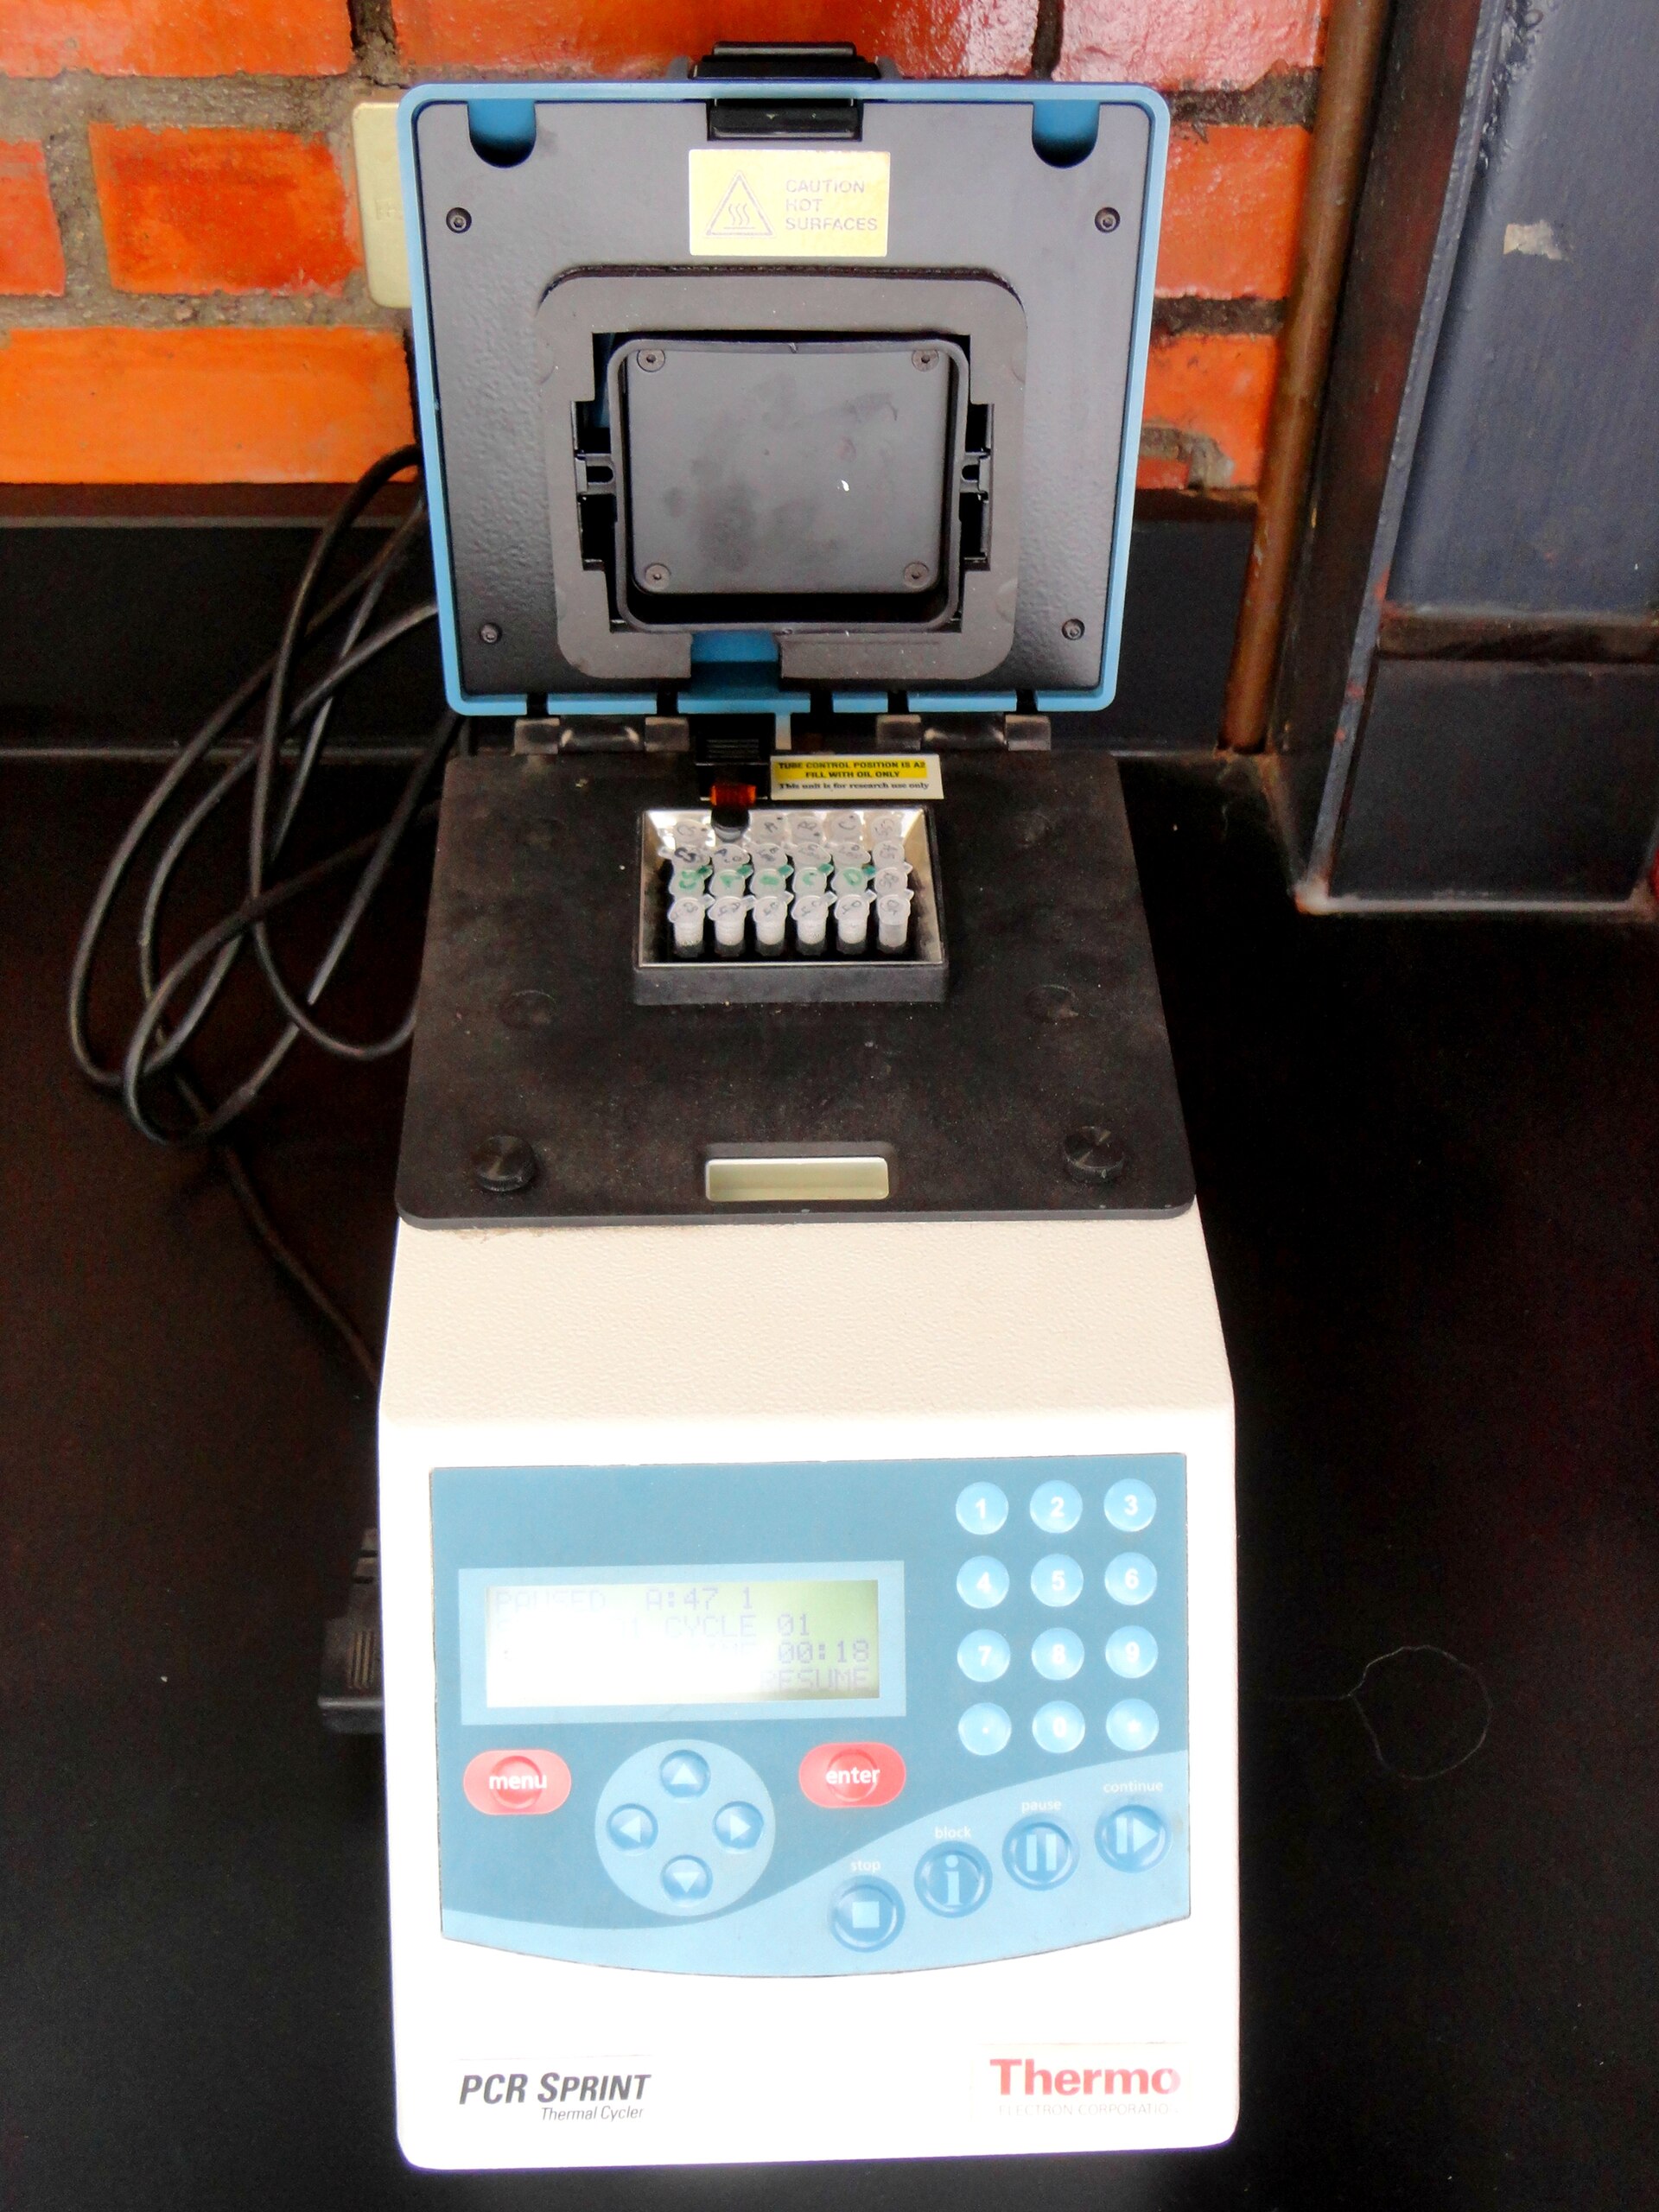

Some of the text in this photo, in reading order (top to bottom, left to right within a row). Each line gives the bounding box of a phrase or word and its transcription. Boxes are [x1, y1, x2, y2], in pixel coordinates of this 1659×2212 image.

[785, 178, 866, 194] CAUTION
[785, 198, 823, 213] HOT
[785, 216, 879, 232] SURFACES
[908, 782, 930, 791] only
[974, 1497, 988, 1519] 1
[1050, 1497, 1065, 1518] 2
[1123, 1494, 1139, 1516] 3
[976, 1571, 993, 1594] 4
[1051, 1569, 1066, 1592] 5
[1124, 1567, 1140, 1590] 6
[664, 1614, 758, 1640] CYCLE
[776, 1612, 810, 1637] 01
[776, 1638, 870, 1665] 00:18
[977, 1645, 993, 1668] 7
[1051, 1643, 1066, 1666] 8
[1125, 1641, 1141, 1663] 9
[488, 1773, 548, 1791] menu
[825, 1767, 881, 1785] enter
[1103, 1779, 1164, 1794] continue
[1020, 1798, 1062, 1814] pause
[934, 1825, 972, 1840] block
[849, 1859, 881, 1874] stop
[989, 2058, 1181, 2096] Thermo
[459, 2072, 652, 2105] PCR SPRINT
[541, 2105, 645, 2122] Thermal Cycler
[1077, 2101, 1180, 2117] CORPORATIO
